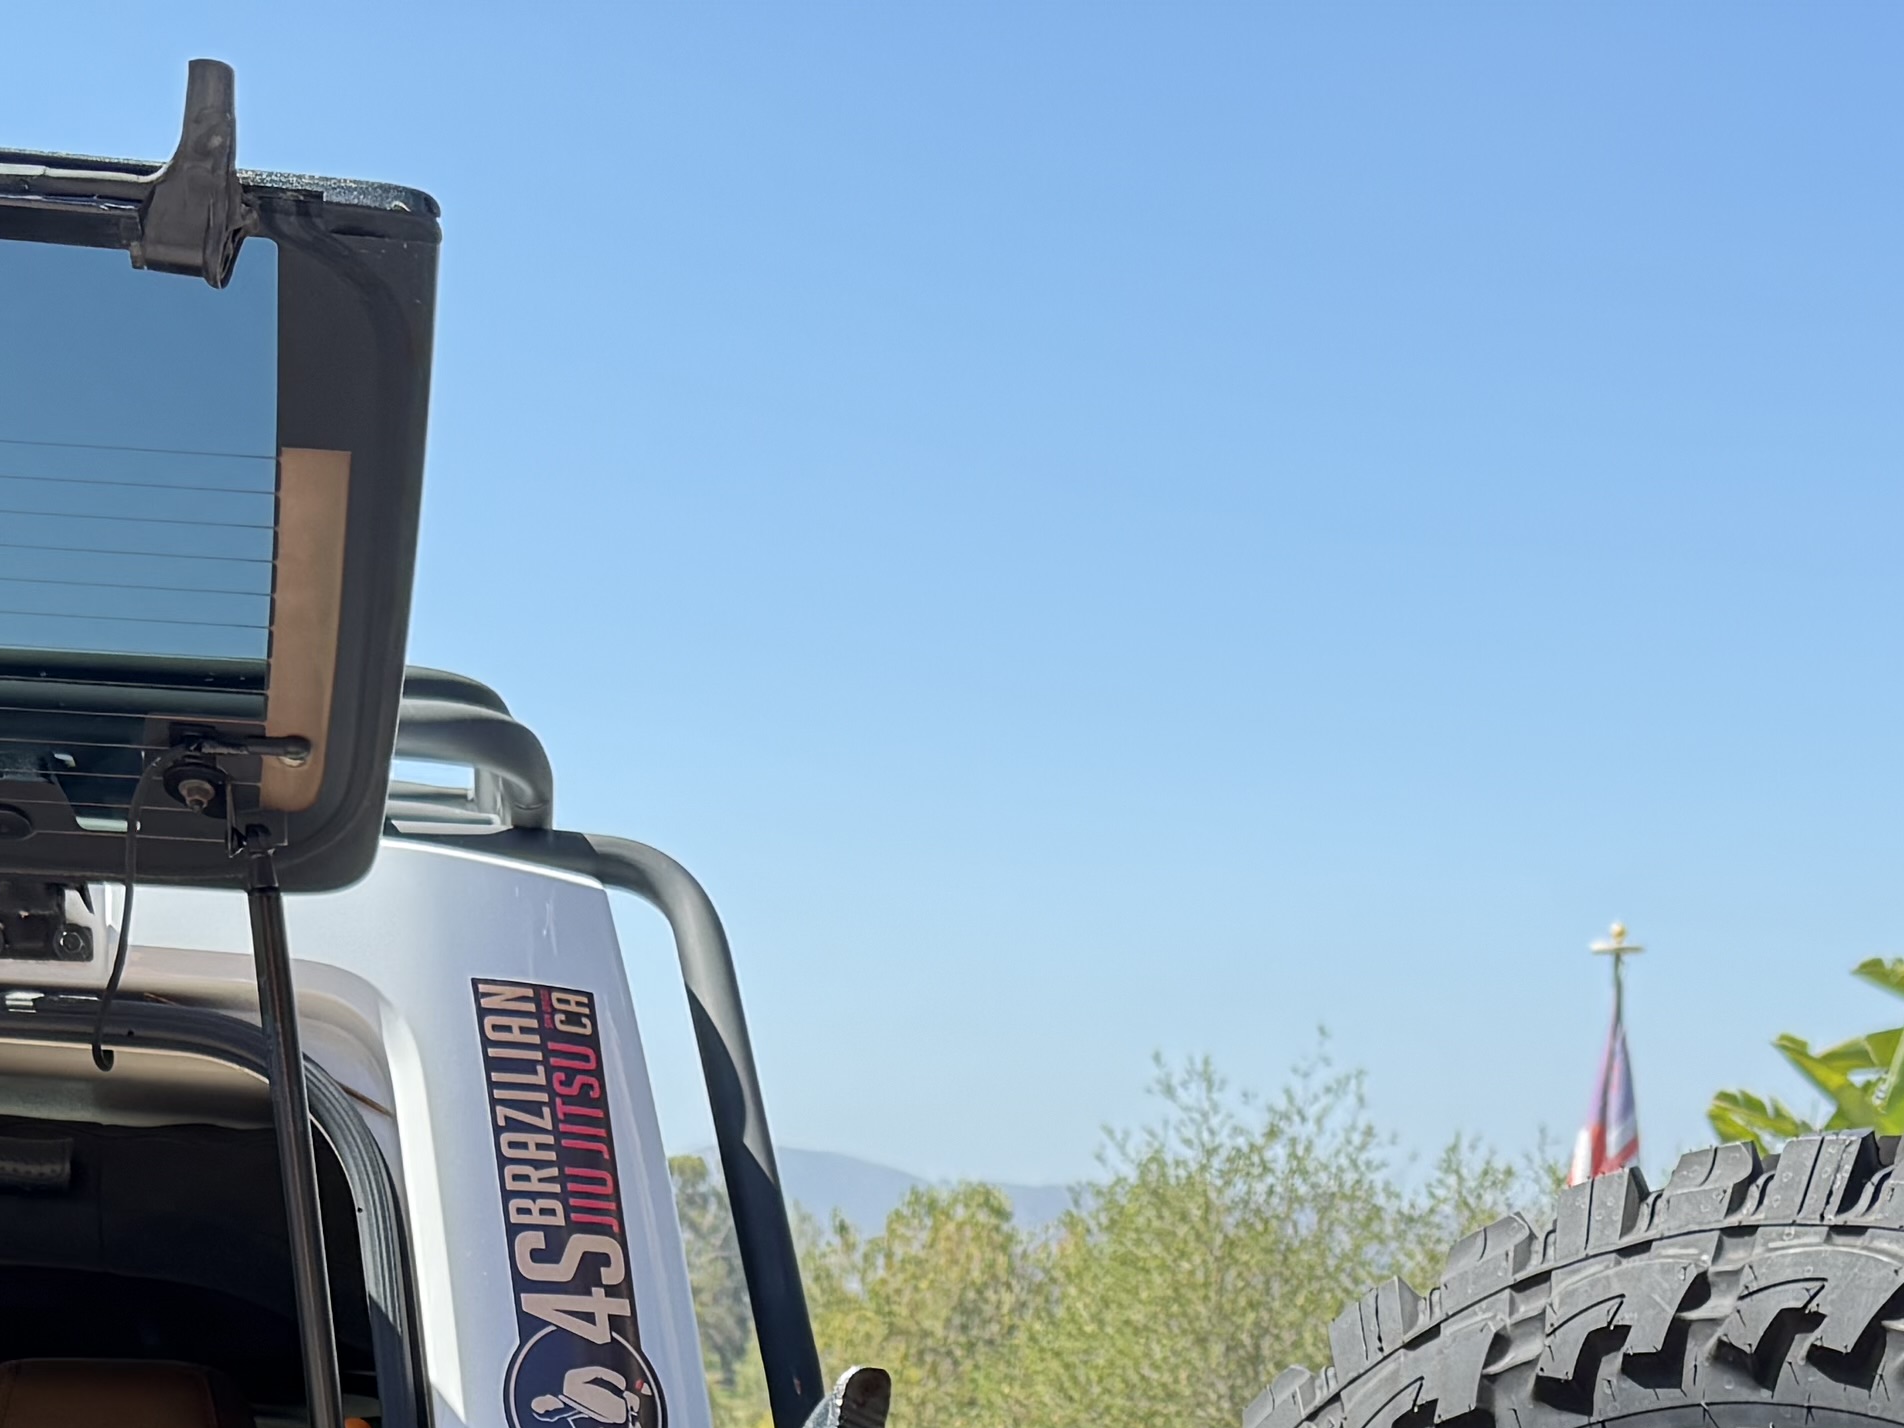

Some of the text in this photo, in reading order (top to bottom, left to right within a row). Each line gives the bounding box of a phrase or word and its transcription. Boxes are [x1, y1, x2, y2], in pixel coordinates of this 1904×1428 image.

[478, 984, 565, 1227] BRAZILIAN
[549, 991, 620, 1233] JIU JITSU CA
[515, 1230, 632, 1344] 4S
